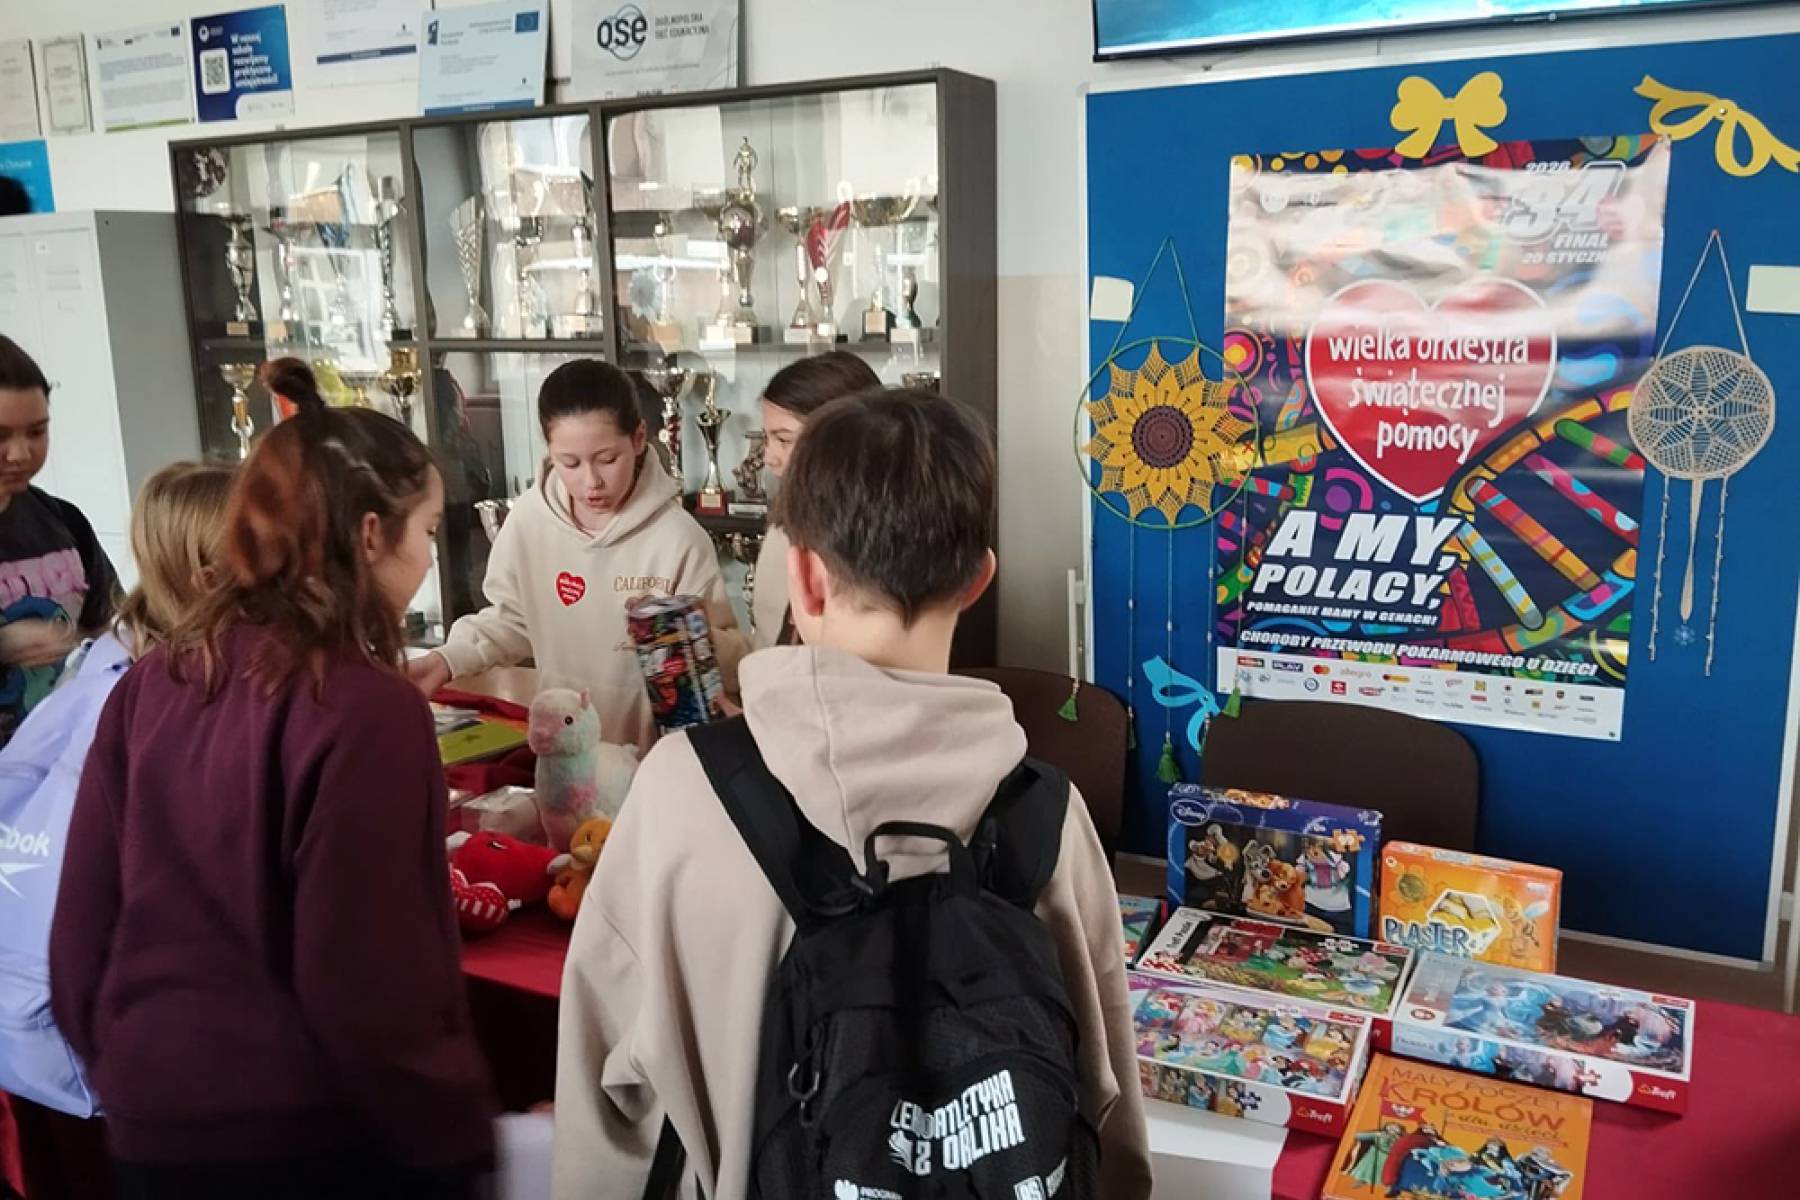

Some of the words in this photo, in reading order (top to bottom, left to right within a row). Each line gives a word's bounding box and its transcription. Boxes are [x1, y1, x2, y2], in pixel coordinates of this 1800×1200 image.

[1347, 367, 1506, 429] świątecznej
[1376, 419, 1479, 465] pomocy
[1265, 510, 1318, 559] A
[1333, 513, 1462, 573] MY,
[1252, 563, 1444, 610] POLACY,
[1246, 601, 1320, 616] POMAGANIE
[1320, 606, 1362, 620] MAMY
[1362, 610, 1378, 621] W
[1241, 630, 1312, 648] CHOROBY
[1311, 637, 1397, 656] PRZEWODU
[1396, 644, 1524, 668] POKARMOWEGO
[1525, 656, 1541, 670] U
[1542, 658, 1599, 677] DZIECI
